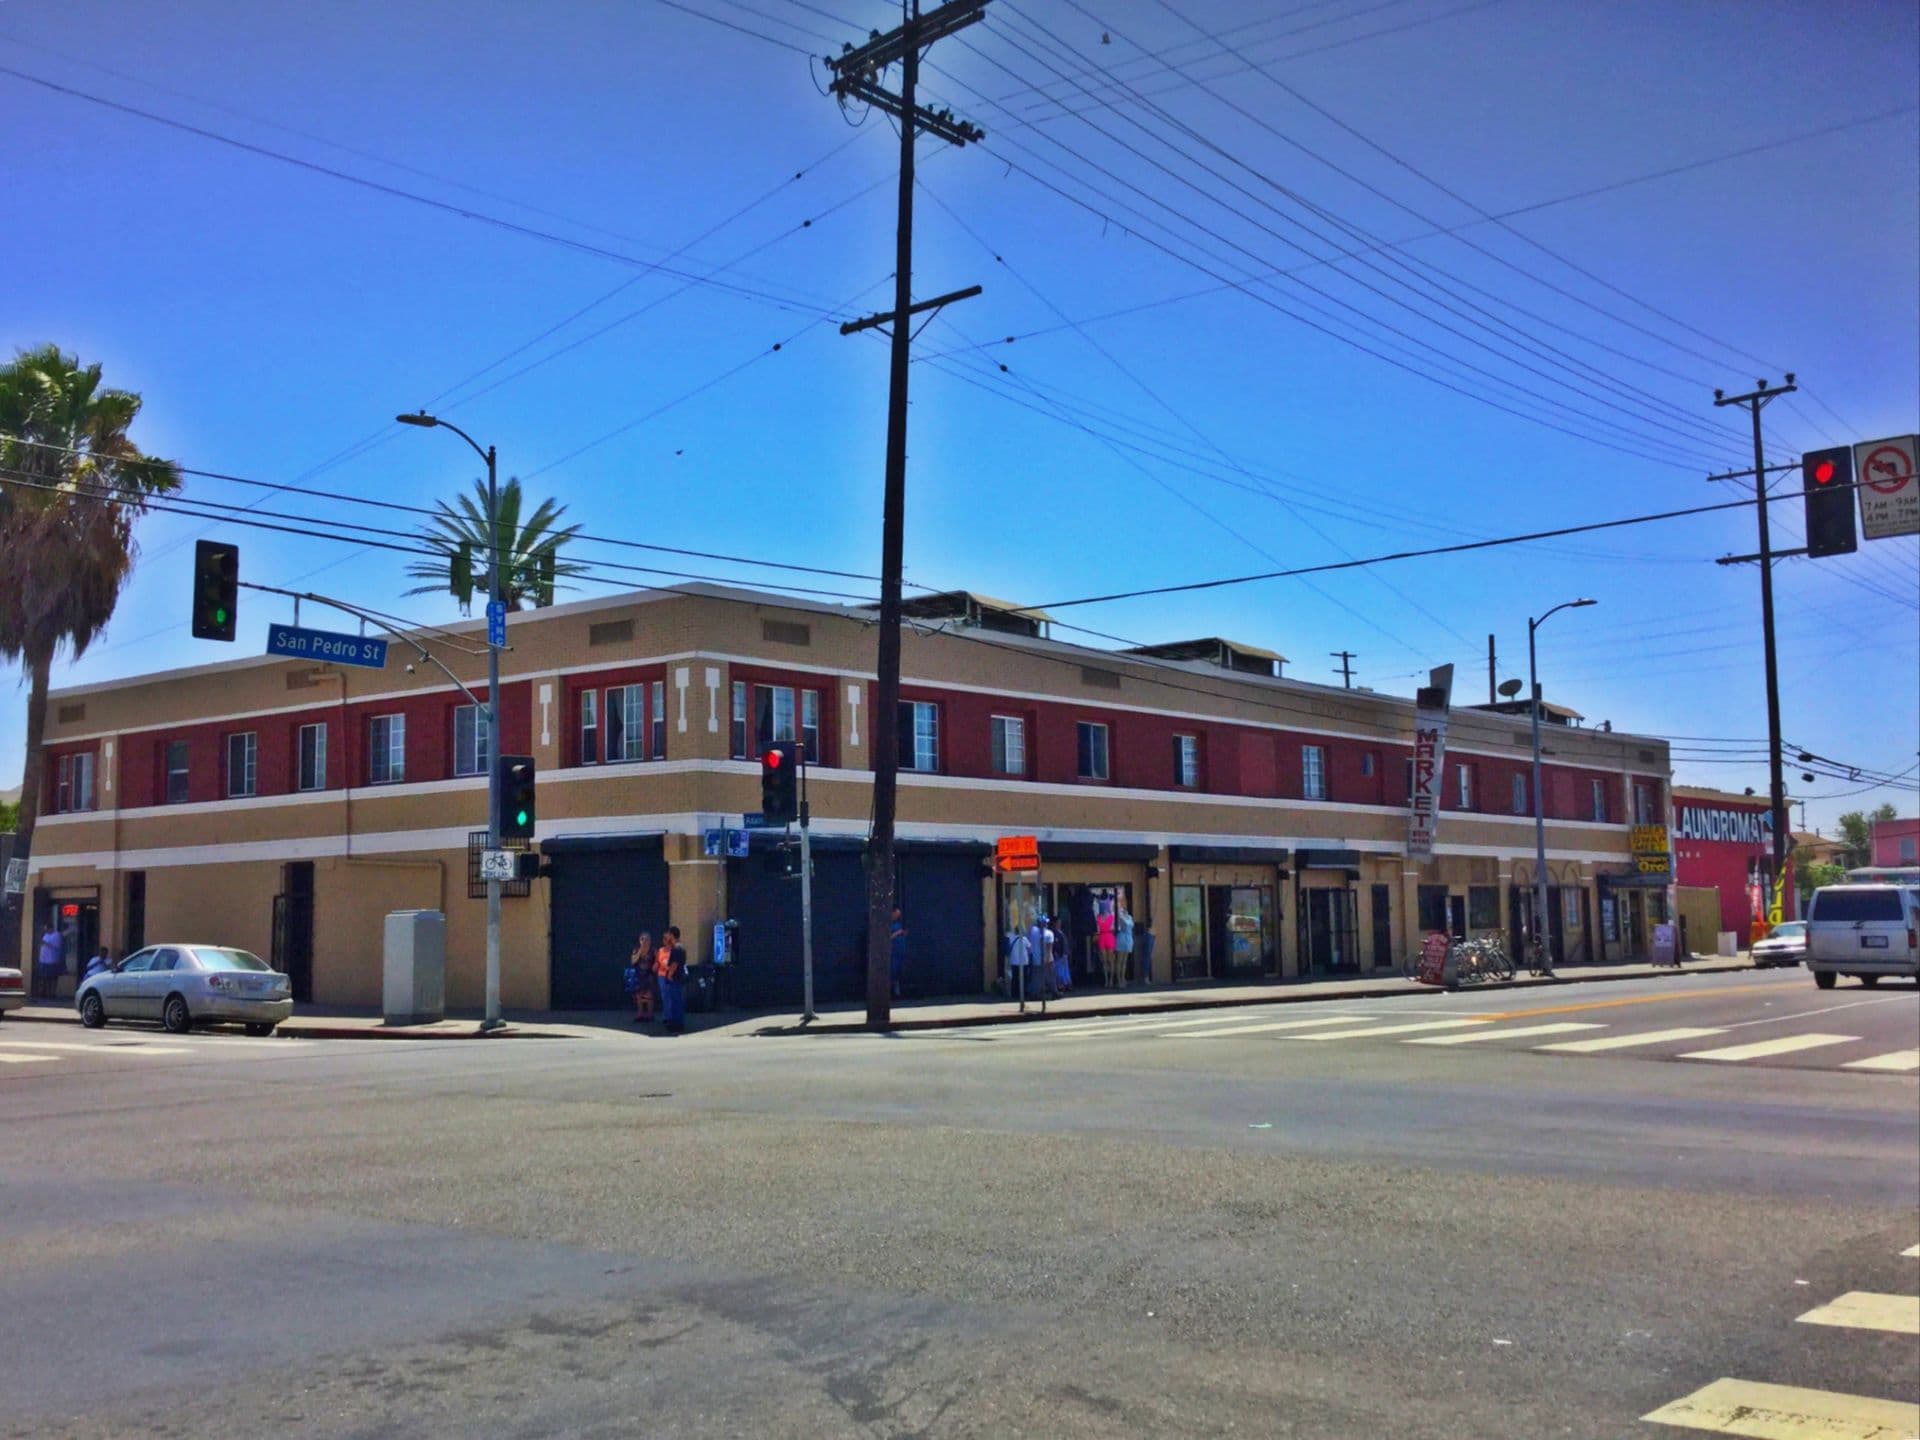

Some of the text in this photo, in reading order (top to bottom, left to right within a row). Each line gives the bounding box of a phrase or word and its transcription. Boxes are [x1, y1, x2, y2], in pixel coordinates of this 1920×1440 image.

[1874, 501, 1887, 510] AM
[276, 632, 380, 660] San Pedro St
[1415, 728, 1438, 828] MARKET
[1672, 805, 1767, 844] LAUNDROMAT
